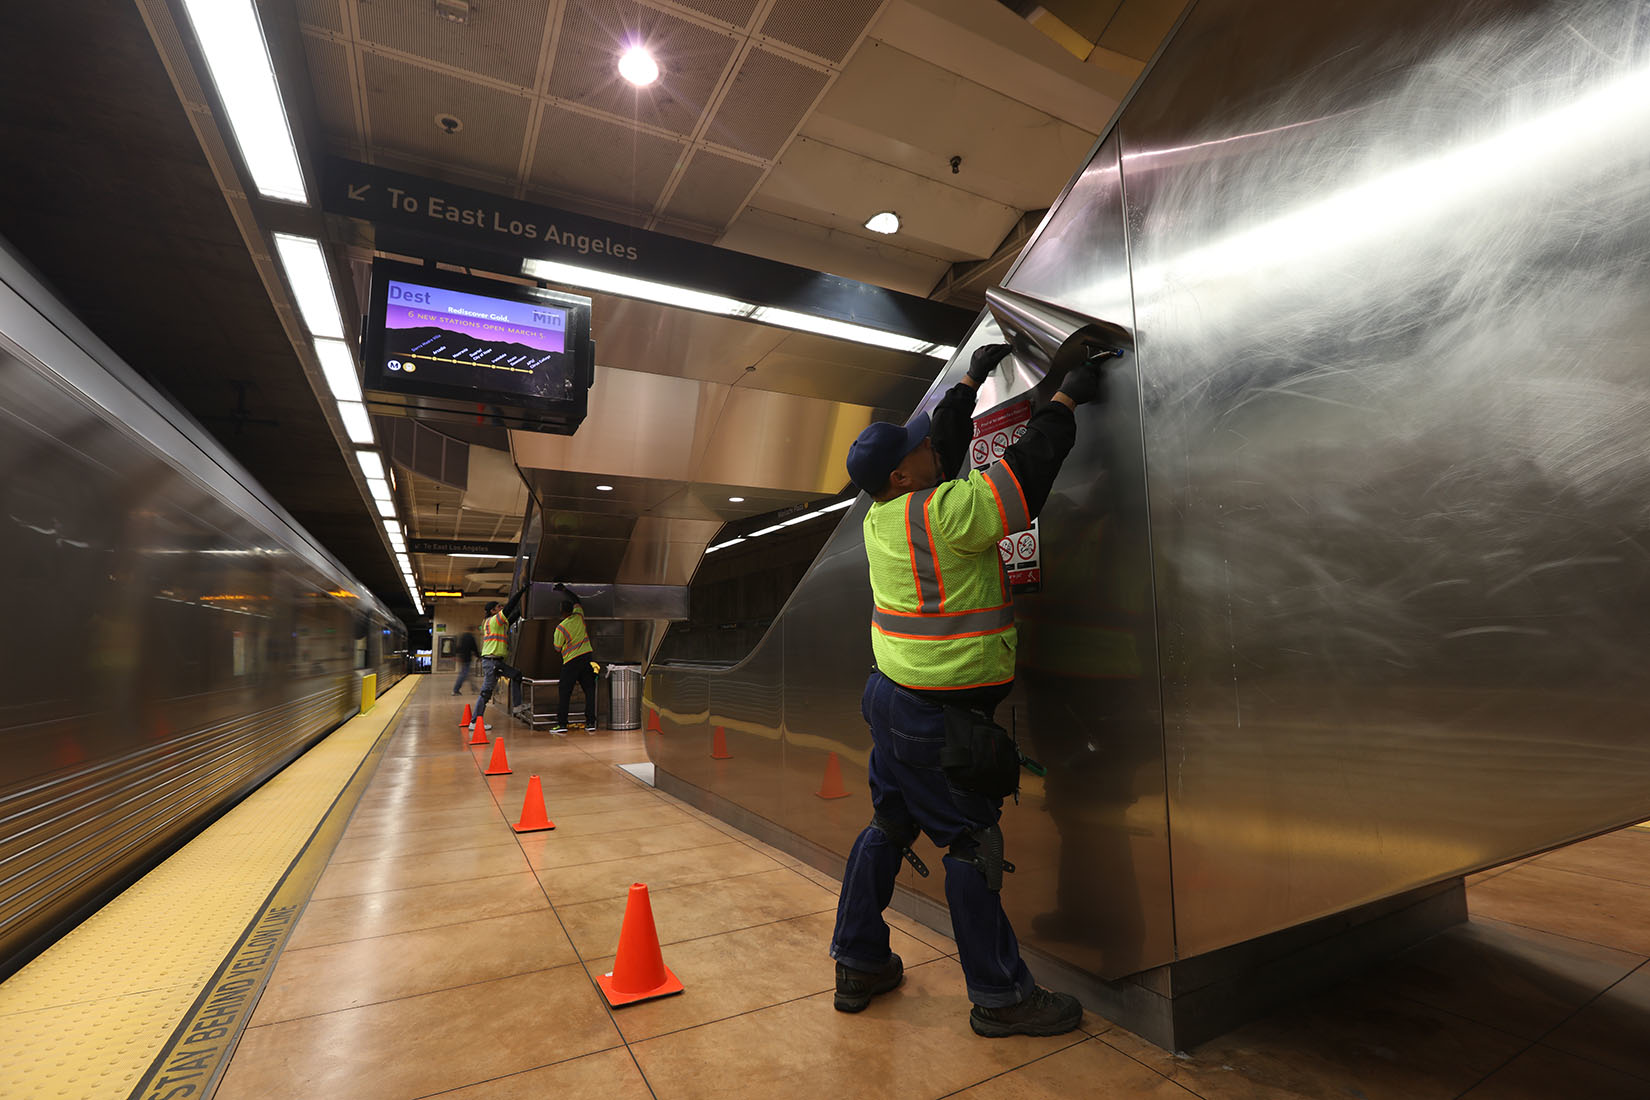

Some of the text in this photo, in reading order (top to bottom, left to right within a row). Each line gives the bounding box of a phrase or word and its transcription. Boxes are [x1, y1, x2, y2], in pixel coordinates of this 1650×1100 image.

[387, 187, 639, 261] To East Los Angeles
[389, 285, 431, 305] Dest
[408, 310, 415, 318] 6
[417, 313, 436, 321] NEW
[440, 316, 481, 329] STATIONS
[483, 323, 505, 332] OPEN
[507, 327, 537, 337] MARCH
[447, 306, 510, 323] Rediscover Gold.
[532, 310, 561, 326] Min
[434, 543, 448, 551] East
[463, 544, 489, 553] Angeles
[147, 904, 298, 1100] STAY BEHIND YELLOW LINE
